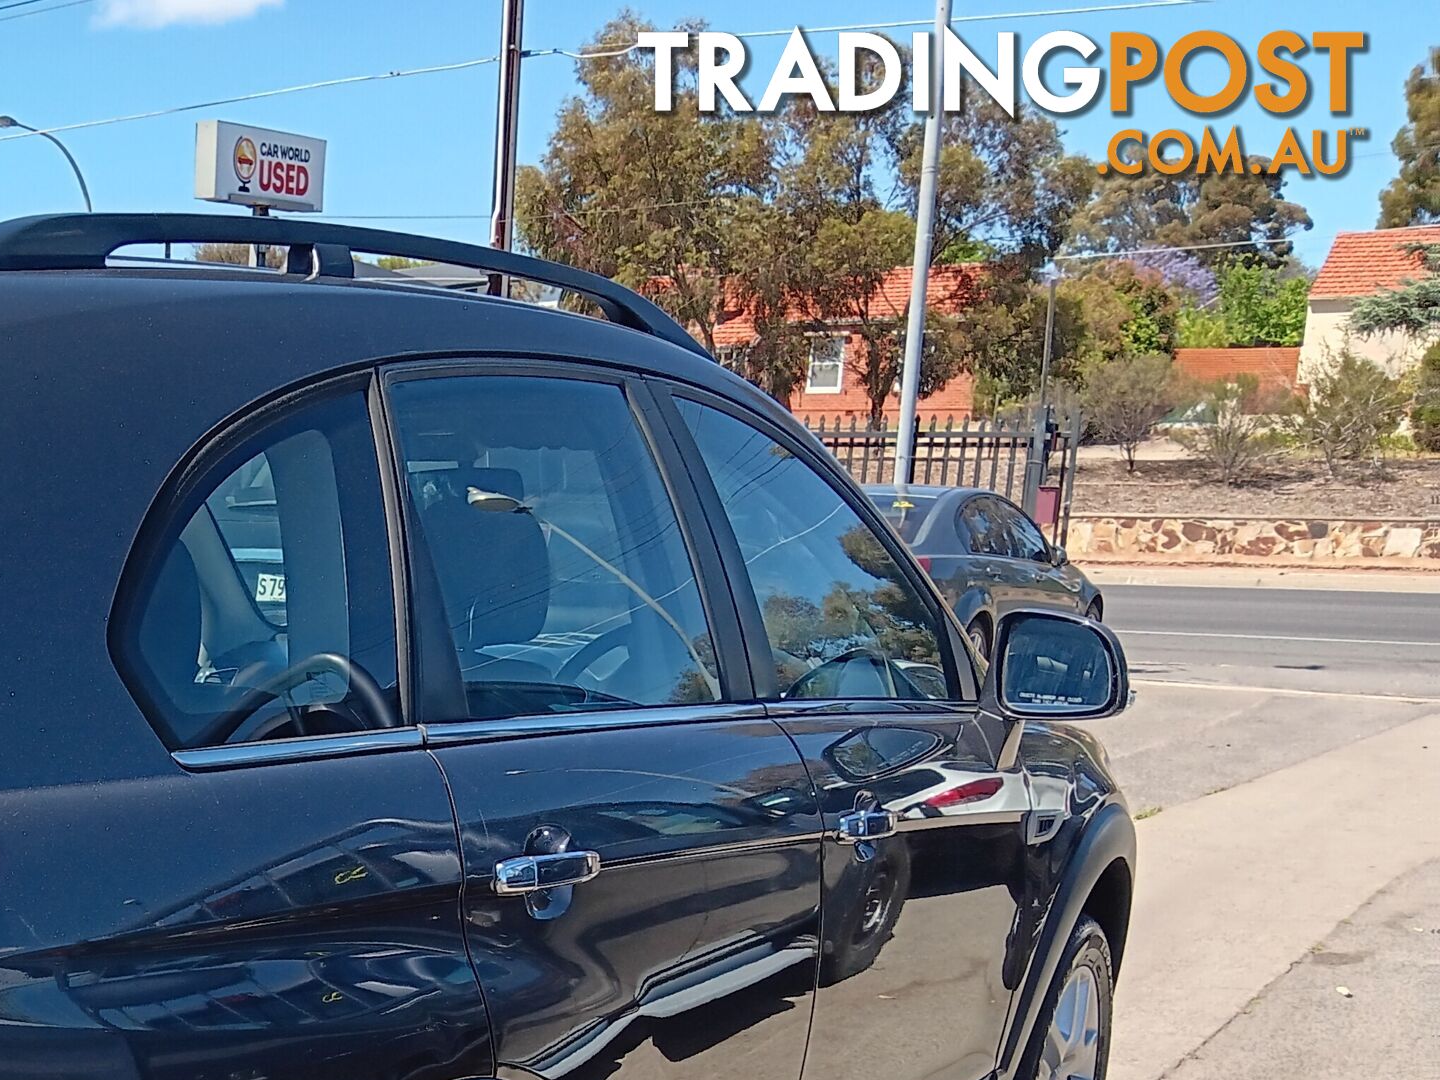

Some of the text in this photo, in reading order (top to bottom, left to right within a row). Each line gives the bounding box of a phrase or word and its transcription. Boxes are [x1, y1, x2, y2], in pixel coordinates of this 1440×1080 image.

[259, 142, 311, 163] CAR WORLD
[258, 159, 309, 197] USED
